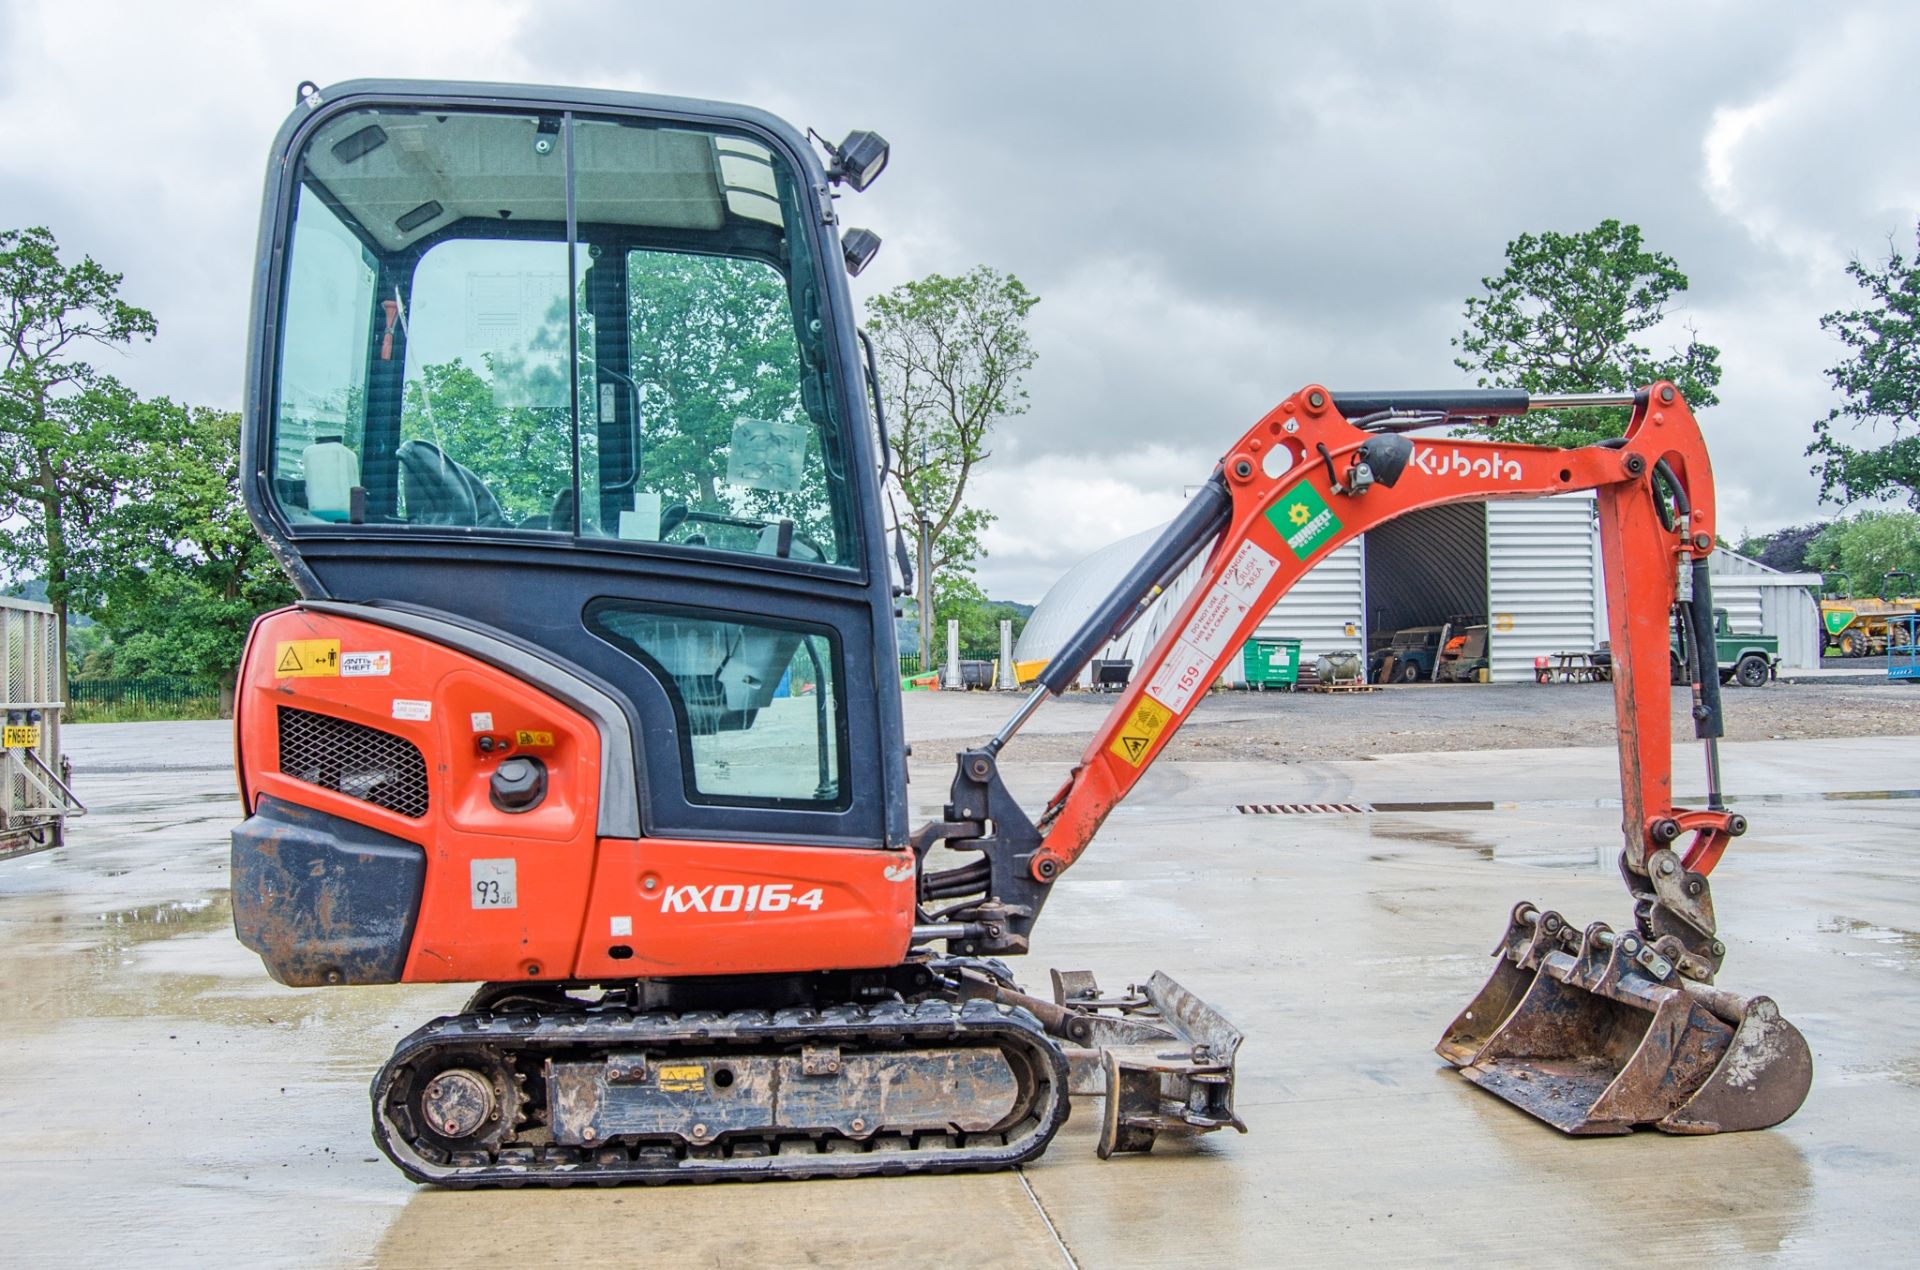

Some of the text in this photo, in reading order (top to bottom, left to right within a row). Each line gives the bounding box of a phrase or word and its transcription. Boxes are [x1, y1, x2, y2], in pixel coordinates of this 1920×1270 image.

[1409, 445, 1523, 481] Kubota
[1287, 507, 1333, 550] SUNBELT
[1224, 548, 1248, 580] DANGER
[1236, 556, 1258, 587] CRUSH
[1246, 567, 1265, 589] AREA
[1190, 596, 1217, 634] DO NOT USE
[1192, 593, 1229, 645] THIS EXCAVATOR
[1214, 606, 1231, 628] CRANE
[343, 657, 367, 665] ANTI
[1176, 666, 1200, 693] 159
[476, 880, 500, 906] 93
[660, 883, 825, 914] KX016-4
